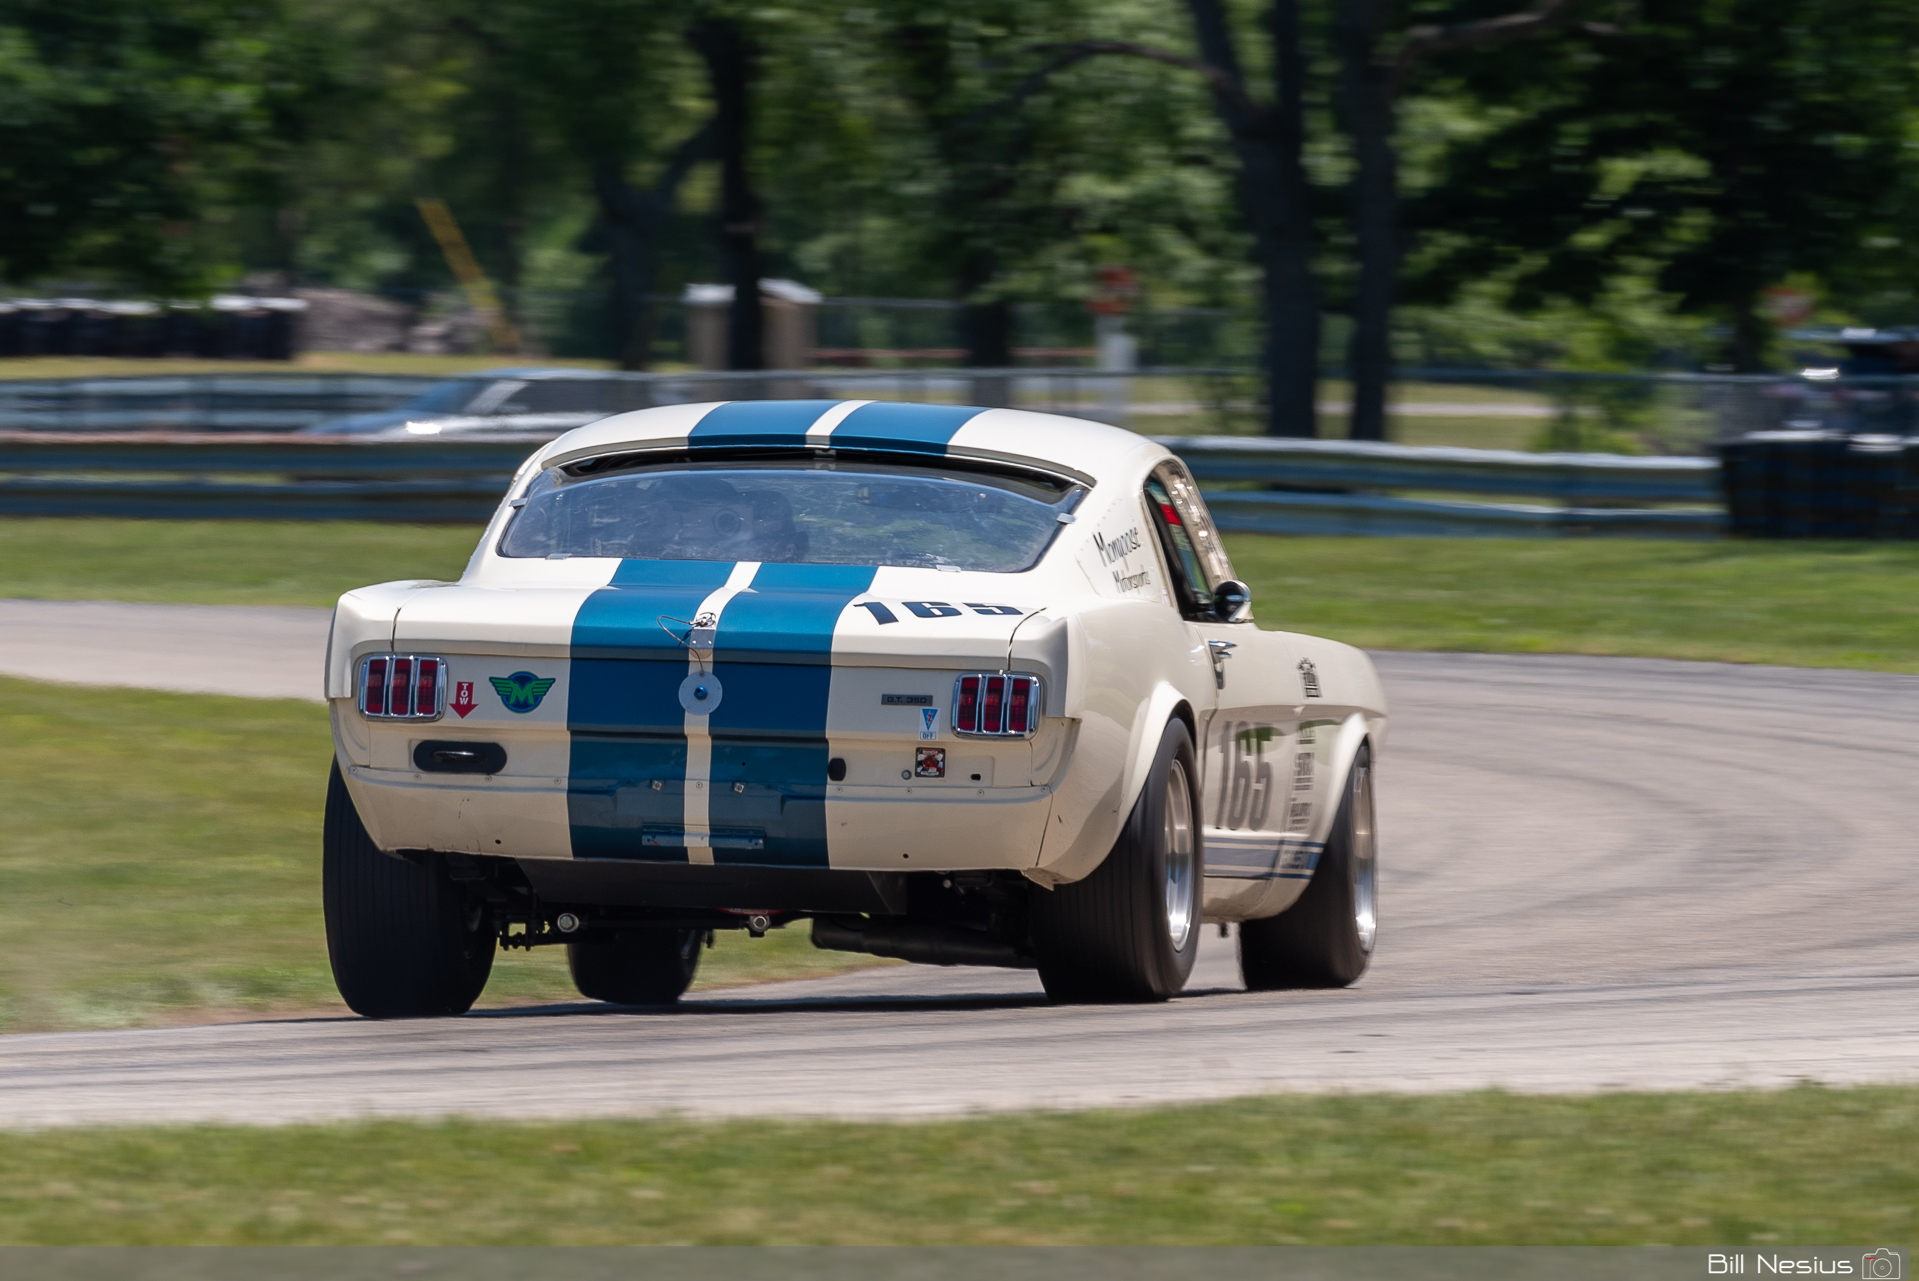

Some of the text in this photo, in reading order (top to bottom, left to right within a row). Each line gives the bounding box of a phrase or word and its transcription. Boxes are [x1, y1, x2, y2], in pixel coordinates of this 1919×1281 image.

[853, 602, 1023, 625] 165
[459, 683, 469, 705] TOW
[906, 696, 928, 704] 350
[922, 732, 934, 740] OFF
[1214, 720, 1274, 832] 165
